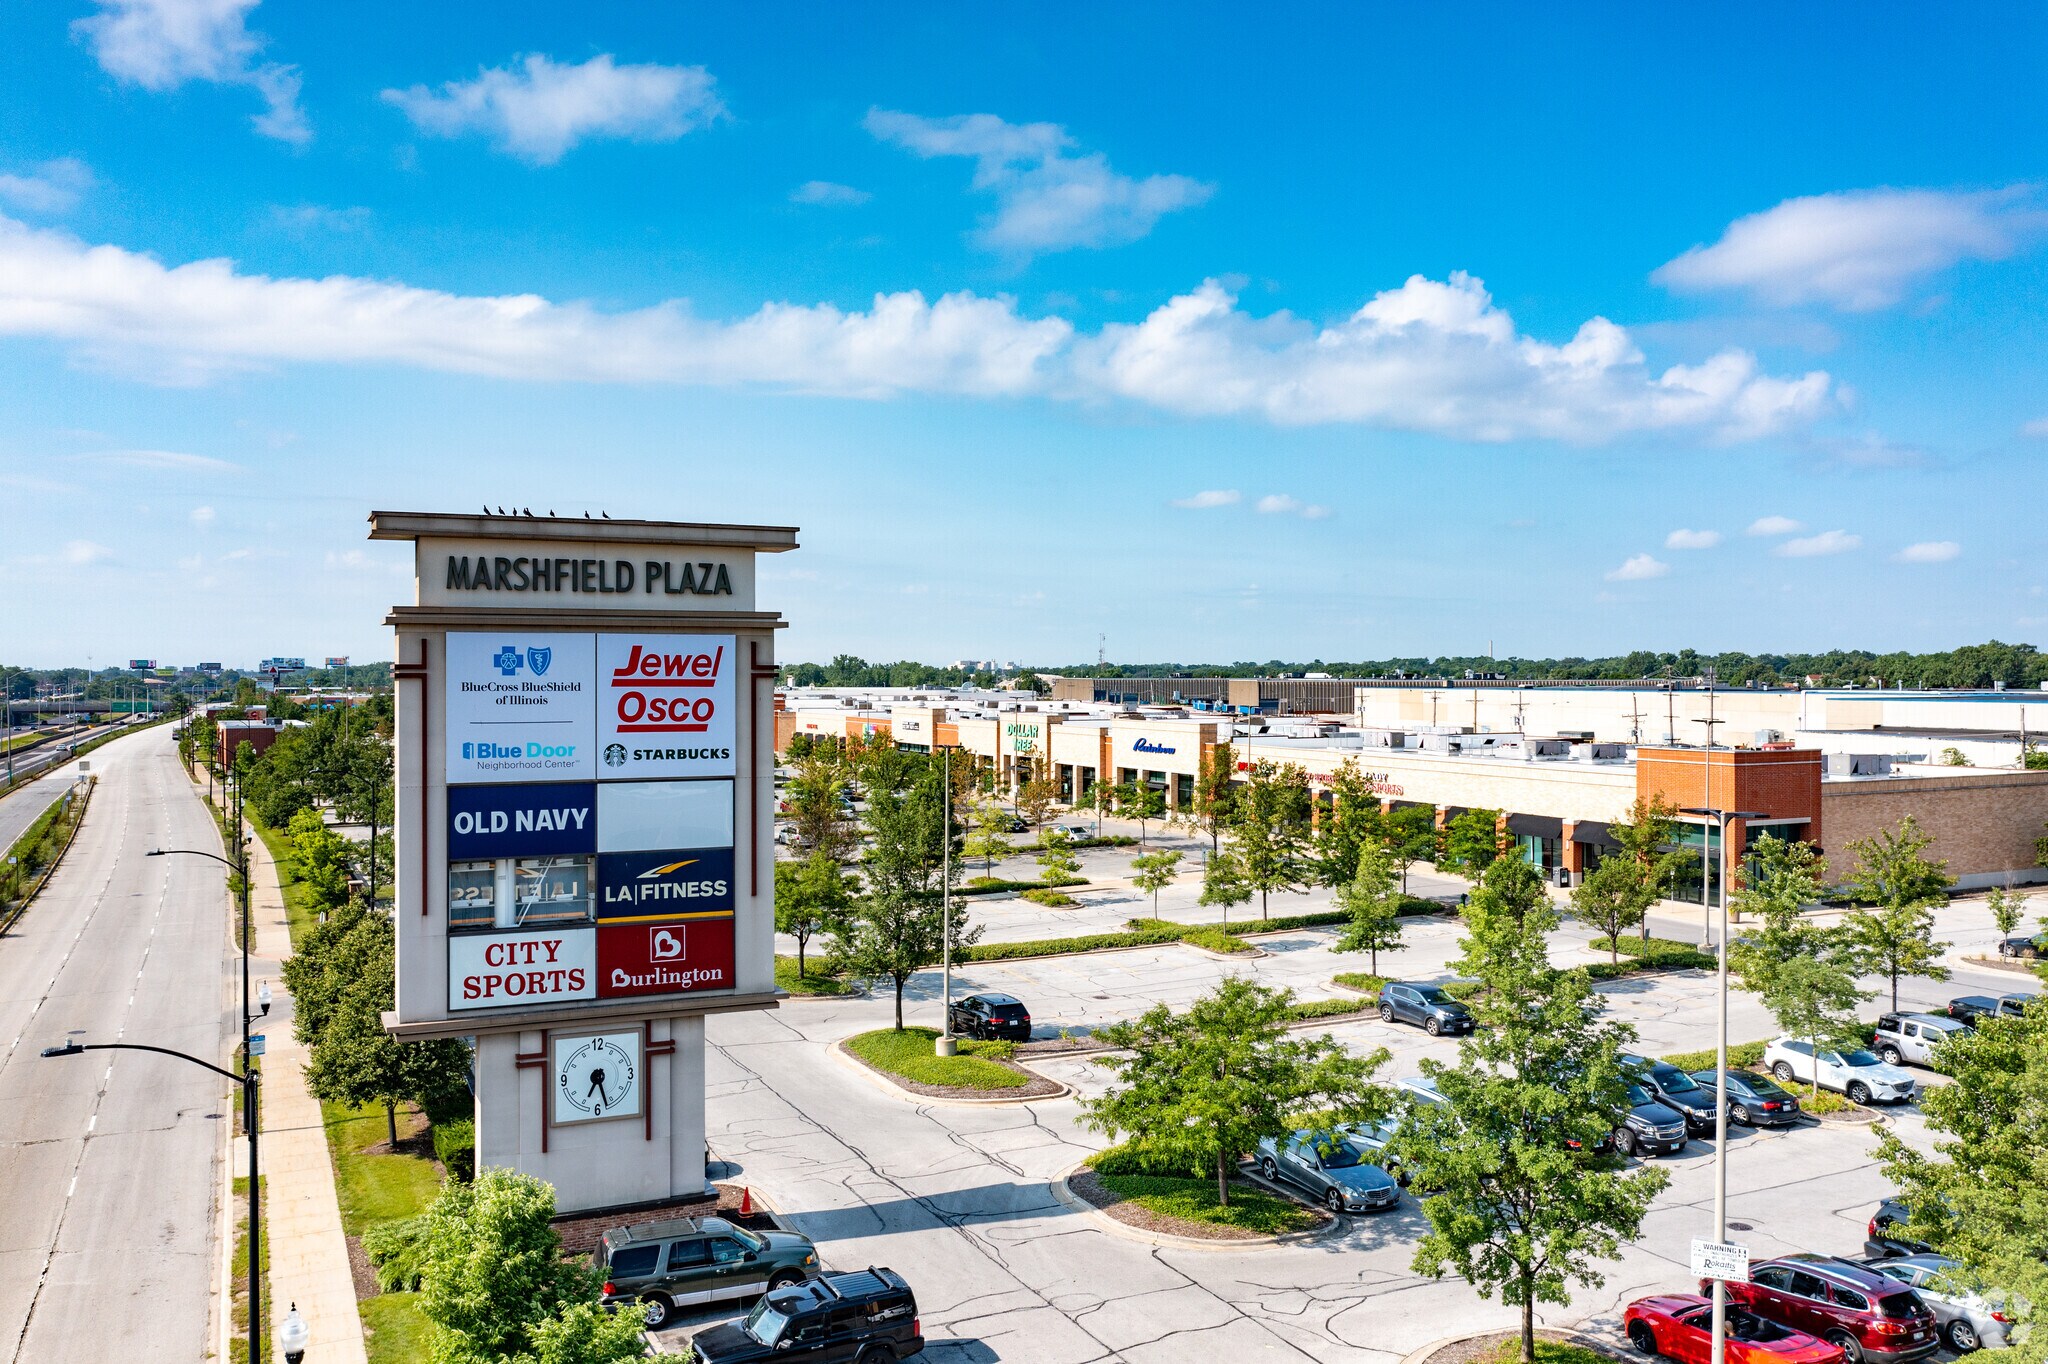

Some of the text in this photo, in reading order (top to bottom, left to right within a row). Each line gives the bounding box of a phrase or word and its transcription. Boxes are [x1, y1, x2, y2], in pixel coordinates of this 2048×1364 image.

[446, 556, 732, 595] MARSHFIELD PLAZA
[613, 645, 724, 678] Jewel
[461, 682, 581, 692] BlueCross BlueShield
[495, 695, 548, 705] of Illinois
[618, 691, 715, 723] Osco
[1007, 723, 1038, 738] DOLLAR
[478, 742, 577, 760] Blue Door
[634, 748, 730, 760] STARBUCKS
[1133, 738, 1176, 755] Rainbow
[478, 761, 542, 772] Neighborhood
[454, 807, 589, 835] OLD NAVY
[605, 880, 727, 903] LA FITNESS
[484, 940, 562, 968] CITY
[464, 969, 586, 1000] SPORTS
[611, 967, 723, 989] Burlington
[590, 1037, 604, 1052] 12
[560, 1074, 568, 1087] 9
[627, 1067, 634, 1081] 3
[594, 1103, 602, 1117] 6
